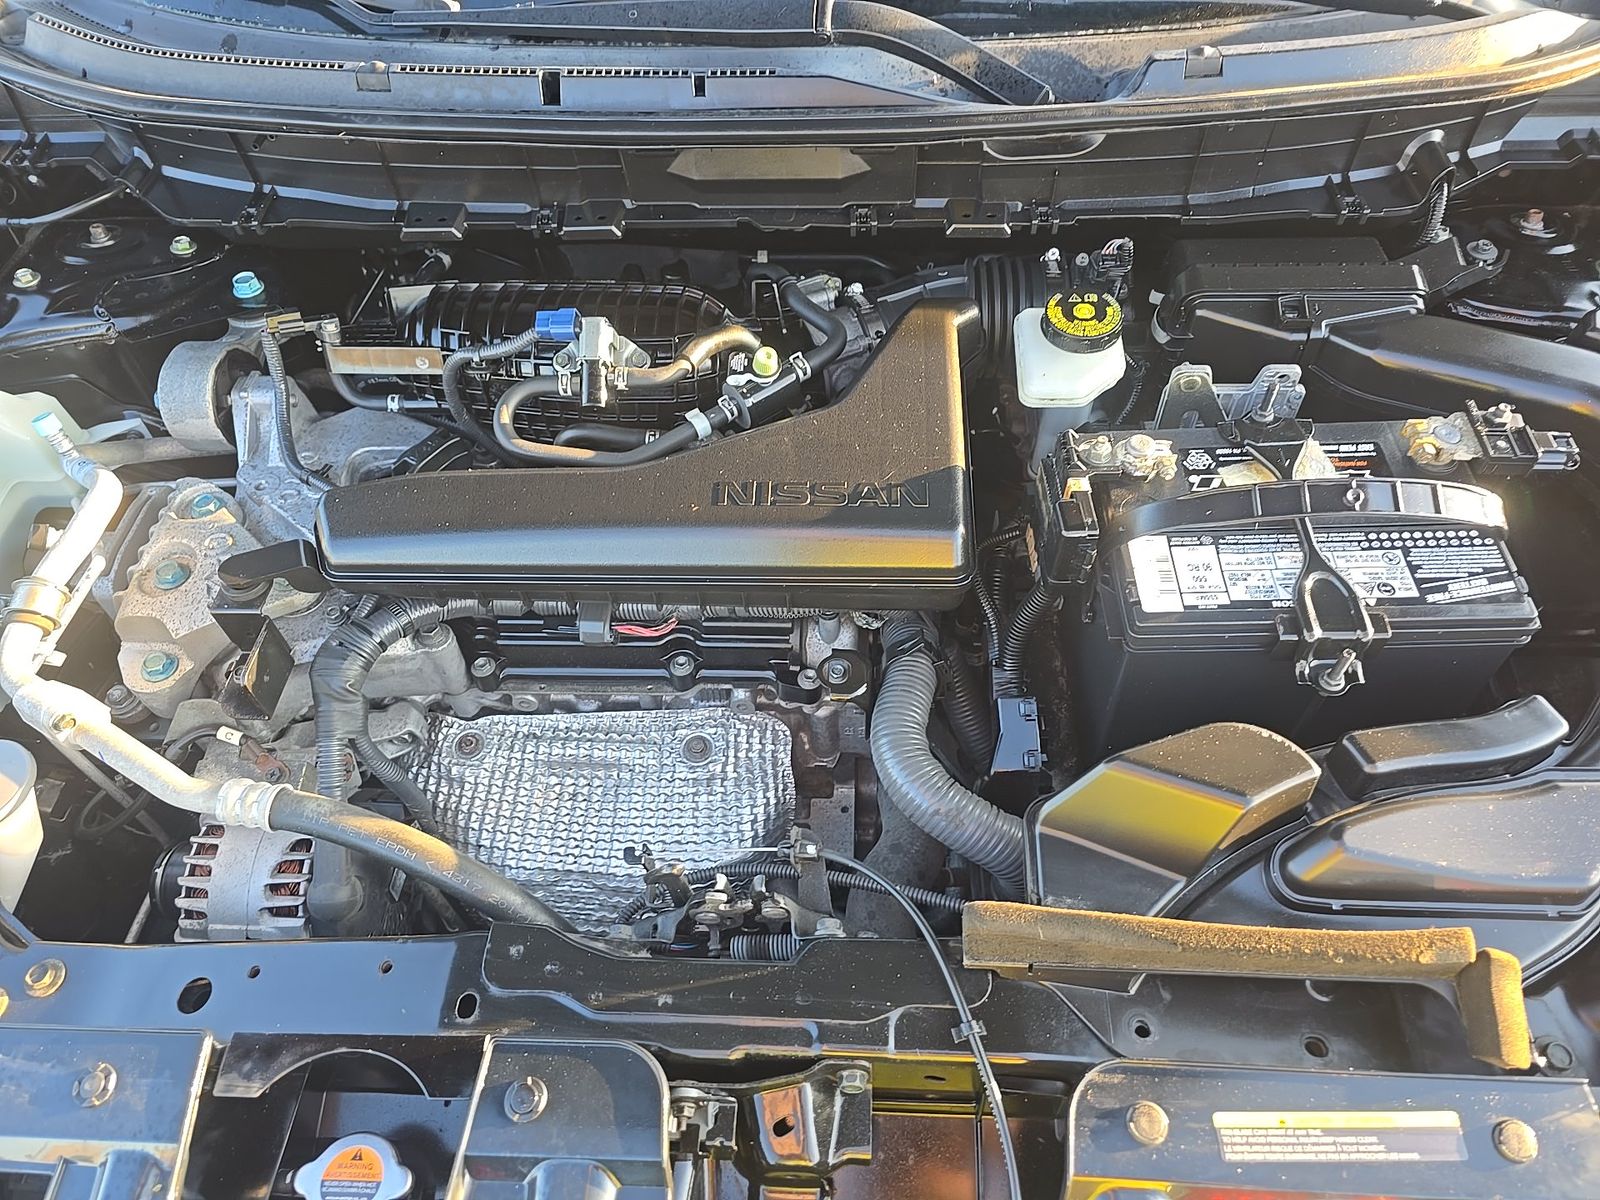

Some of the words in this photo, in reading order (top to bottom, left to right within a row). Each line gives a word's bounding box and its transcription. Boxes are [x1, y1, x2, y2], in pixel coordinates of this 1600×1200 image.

[711, 479, 930, 508] NISSAN
[225, 731, 234, 741] C
[375, 836, 418, 861] EPDM
[336, 1161, 375, 1170] WARNING
